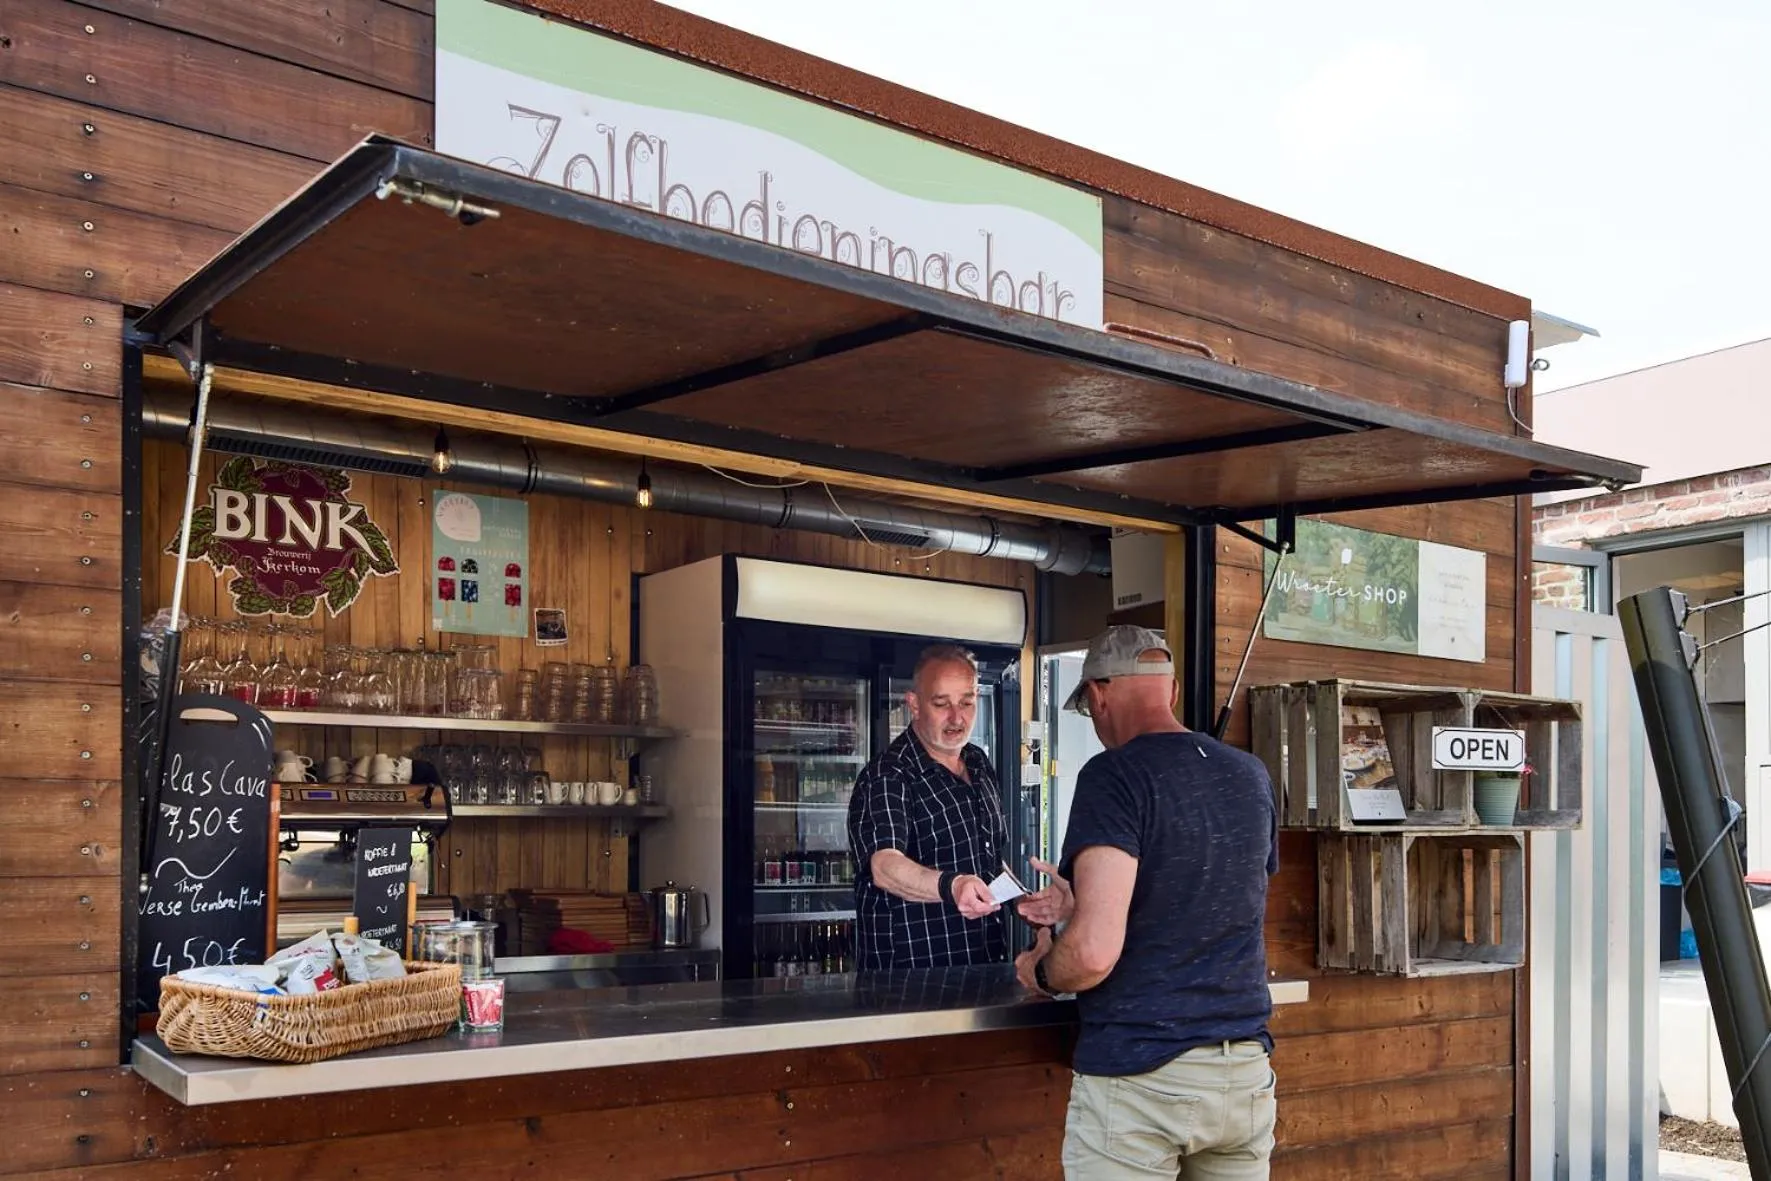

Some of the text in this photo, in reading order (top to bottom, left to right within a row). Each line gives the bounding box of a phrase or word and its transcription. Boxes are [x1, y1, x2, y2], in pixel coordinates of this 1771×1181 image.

[211, 488, 380, 562] BINK
[256, 556, 321, 576] Kerkom
[1364, 584, 1407, 605] SHOP
[1450, 737, 1509, 761] OPEN
[162, 753, 266, 798] las Cava
